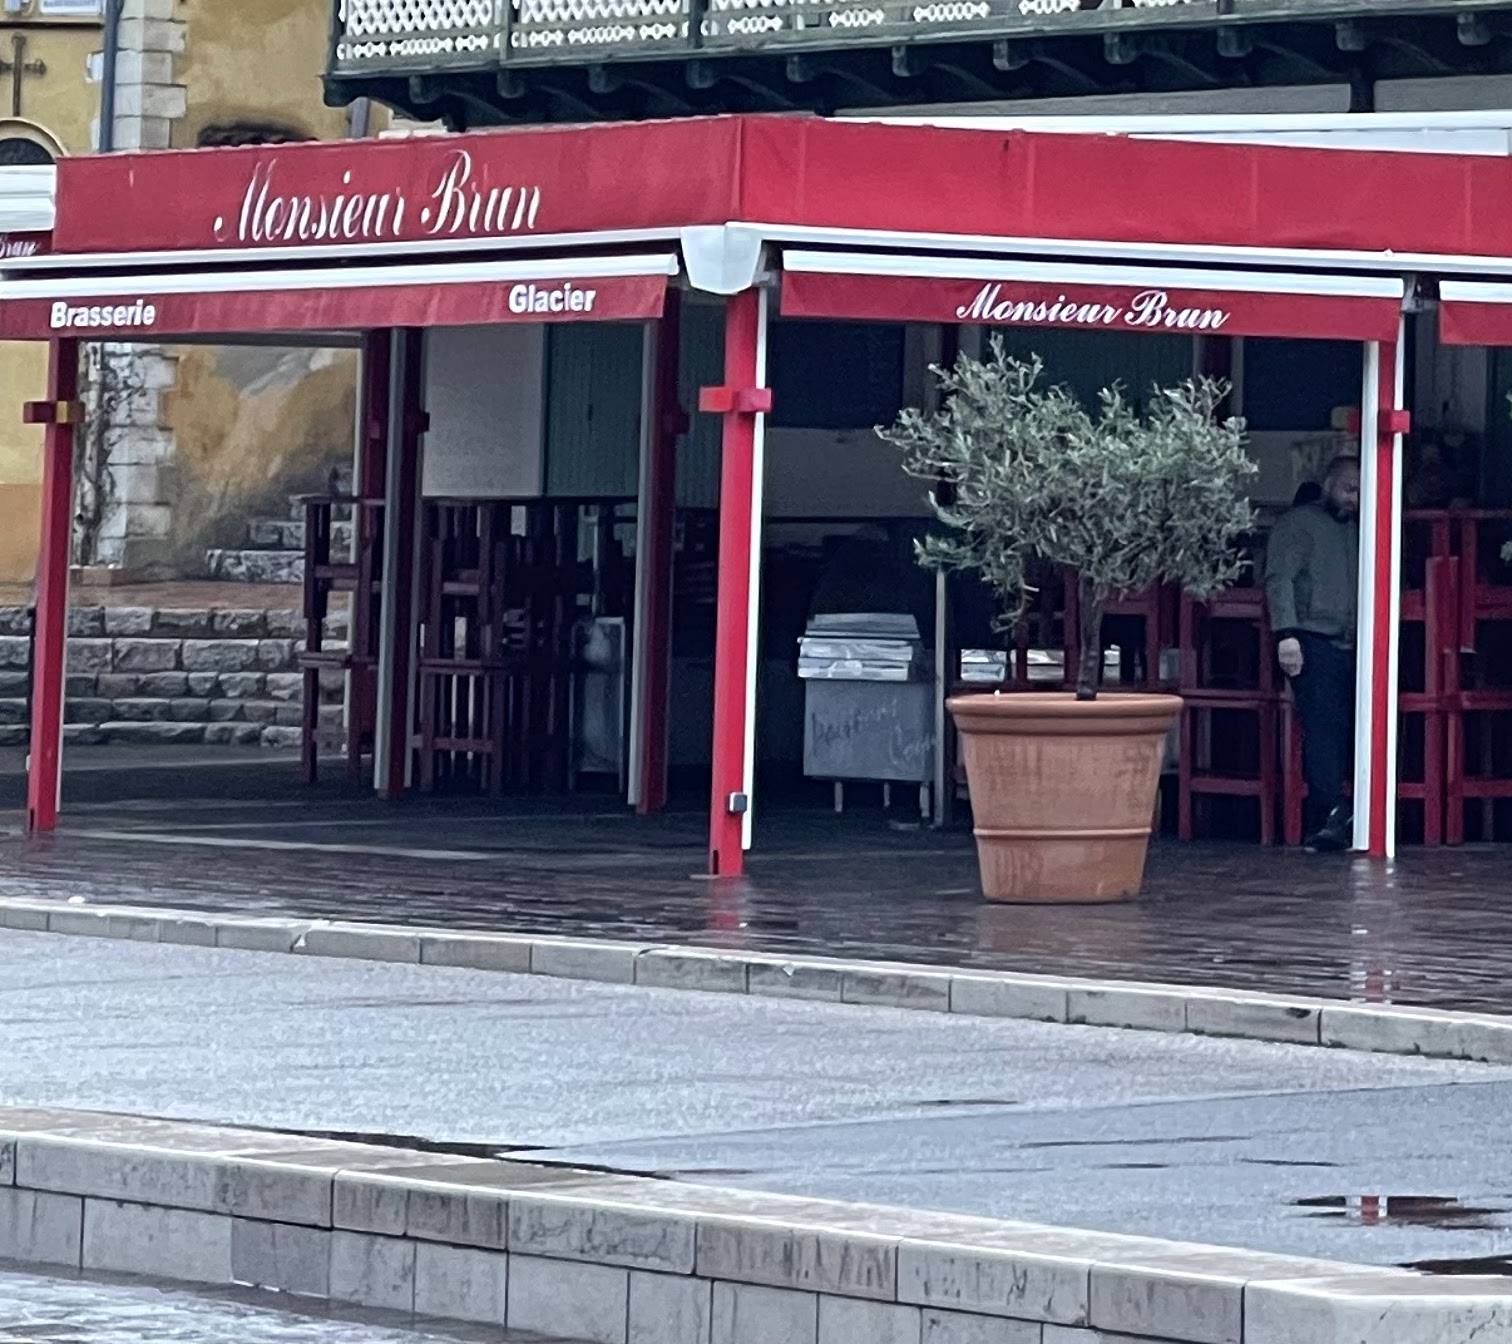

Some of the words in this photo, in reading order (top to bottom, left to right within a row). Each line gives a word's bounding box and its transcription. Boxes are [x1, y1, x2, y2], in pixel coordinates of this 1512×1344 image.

[213, 158, 404, 242] Monsieur
[420, 149, 541, 234] Brun
[50, 299, 156, 328] Brasserie
[508, 282, 597, 313] Glacier
[956, 282, 1123, 325] Monsieur
[1124, 289, 1231, 330] Brun
